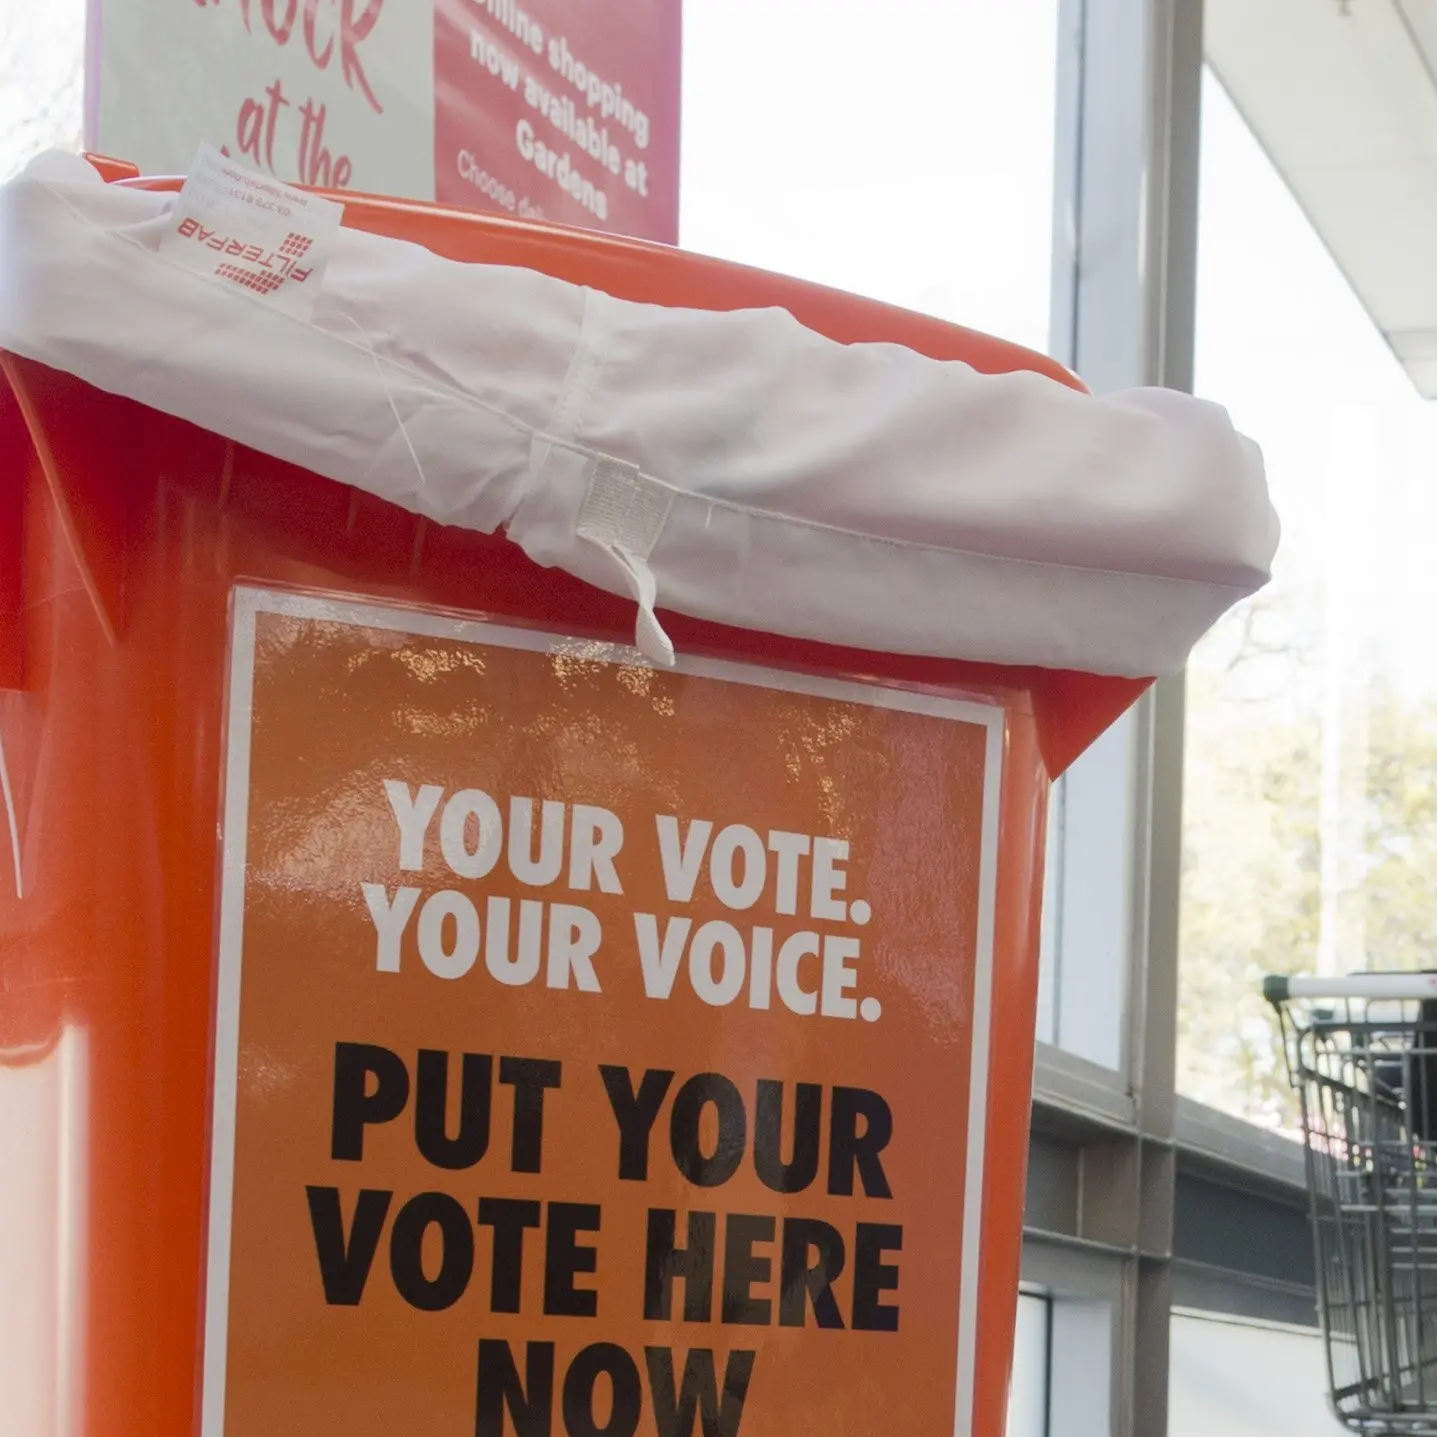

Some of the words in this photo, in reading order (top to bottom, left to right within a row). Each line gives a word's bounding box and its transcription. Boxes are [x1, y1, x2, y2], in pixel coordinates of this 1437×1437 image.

[237, 78, 290, 175] at
[298, 96, 353, 188] the
[470, 29, 519, 91] now
[524, 76, 620, 175] available
[625, 159, 647, 196] at
[548, 37, 648, 149] shopping
[516, 119, 607, 221] Gardens
[177, 217, 313, 282] FILTERFAB
[383, 779, 624, 895] YOUR
[656, 814, 872, 926] VOTE.
[360, 882, 602, 993] YOUR
[634, 912, 882, 1023] VOICE.
[331, 1041, 562, 1174] PUT
[598, 1064, 894, 1199] YOUR
[305, 1185, 601, 1318] VOTE
[643, 1207, 903, 1332] HERE
